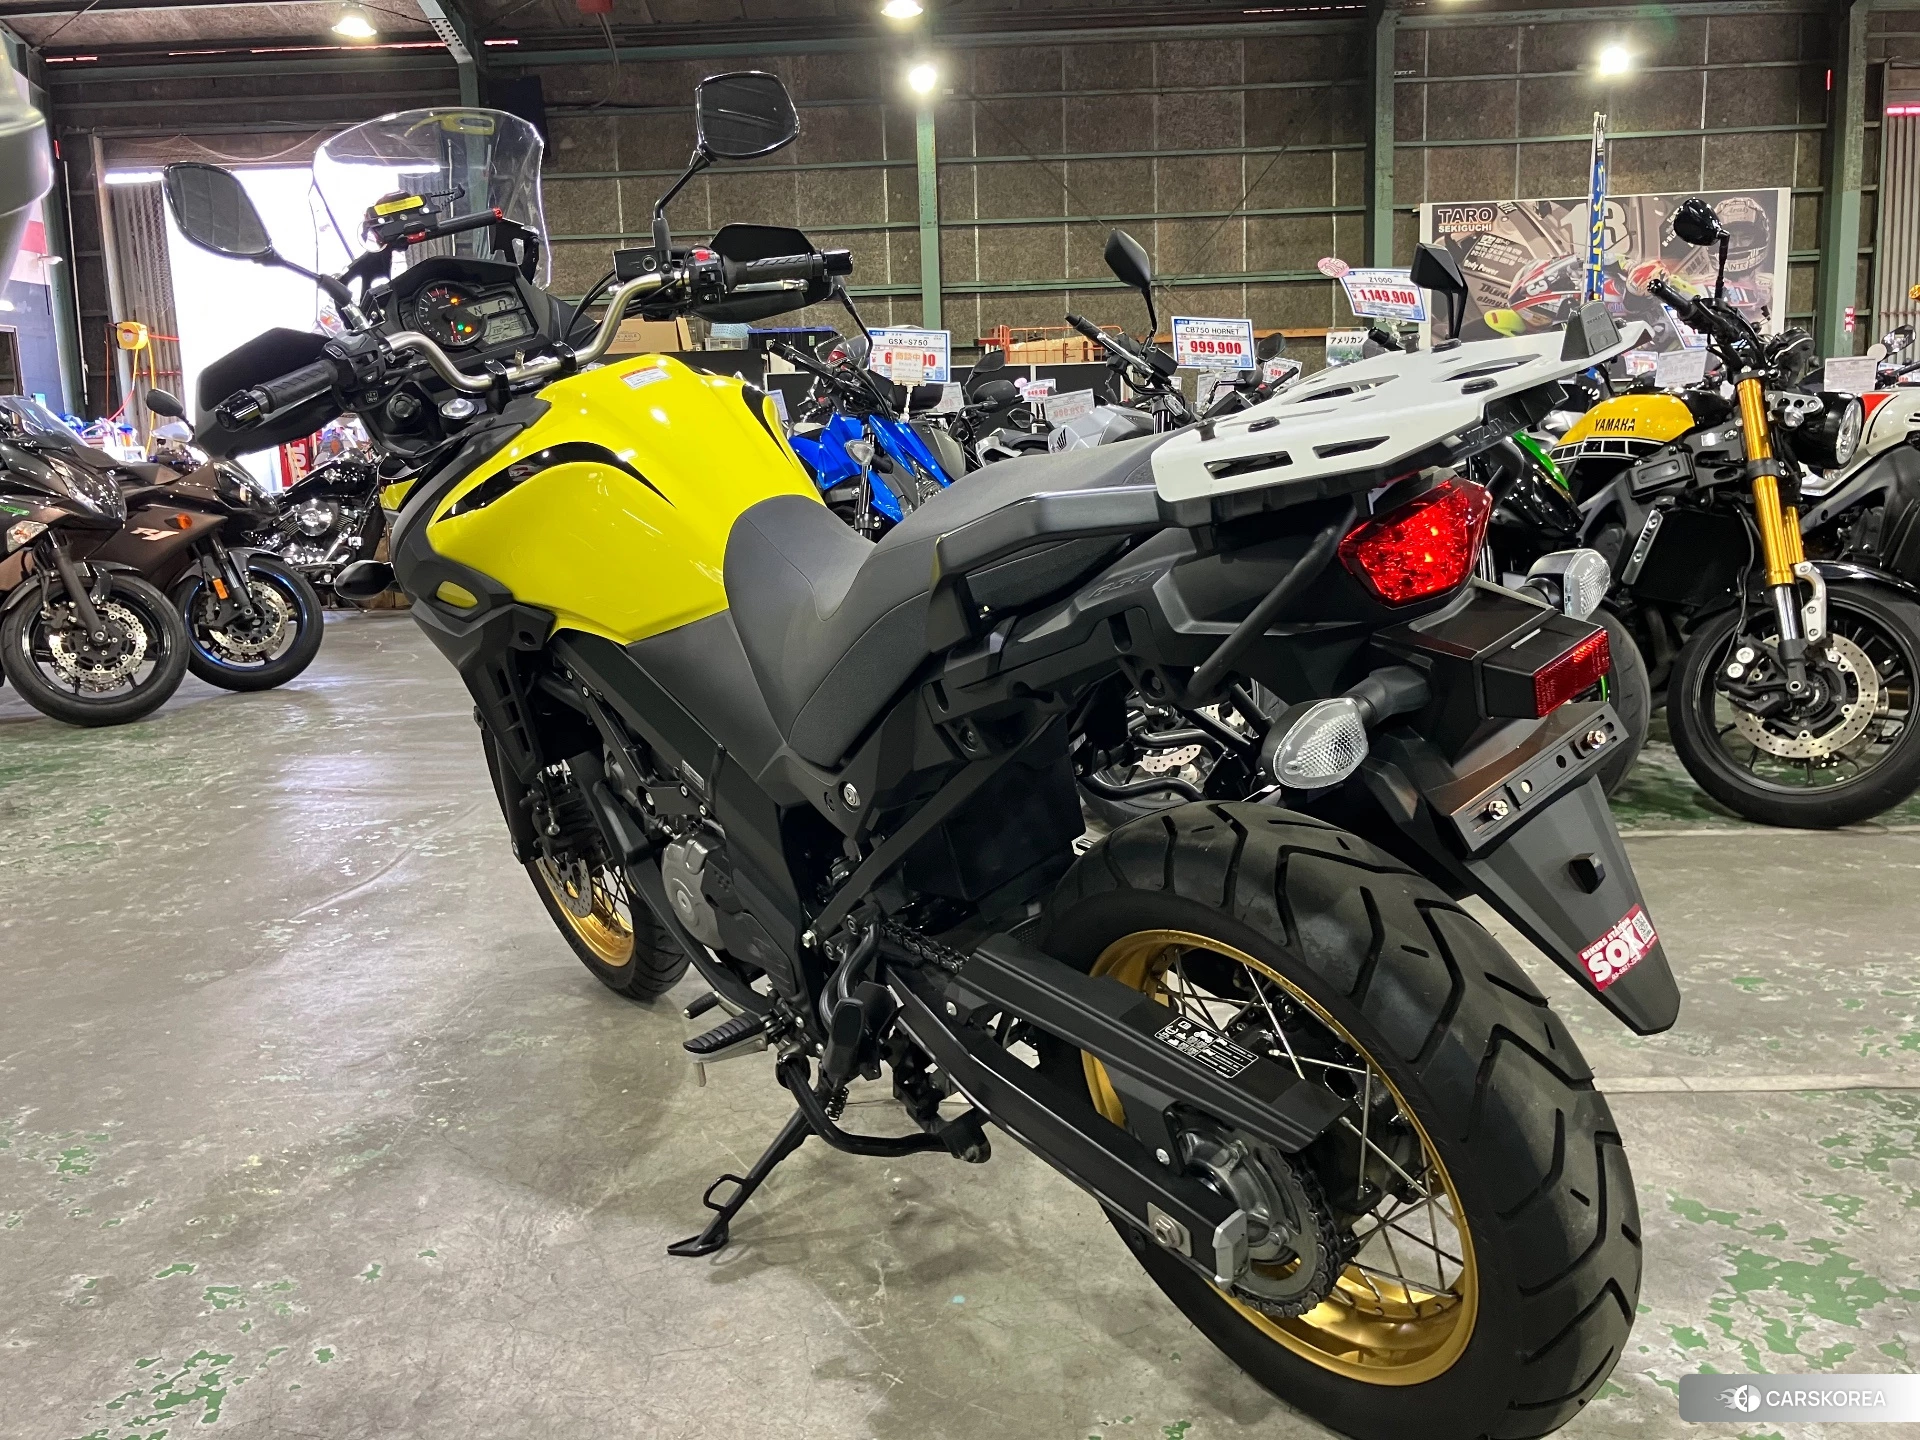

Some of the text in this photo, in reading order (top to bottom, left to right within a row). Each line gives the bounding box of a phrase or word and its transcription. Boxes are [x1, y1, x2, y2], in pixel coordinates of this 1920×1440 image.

[1438, 207, 1493, 224] TARO
[1438, 223, 1492, 233] SEKIGUCHI
[1359, 288, 1416, 305] 1,149,900
[474, 306, 483, 315] N
[1185, 326, 1240, 336] CB750 HORNET
[888, 338, 928, 346] GSX-S750
[1330, 335, 1364, 345] アメリカン
[1189, 340, 1242, 355] 999,900
[1594, 418, 1636, 432] YAMAHA
[130, 526, 180, 541] R1
[1588, 924, 1646, 983] SOX
